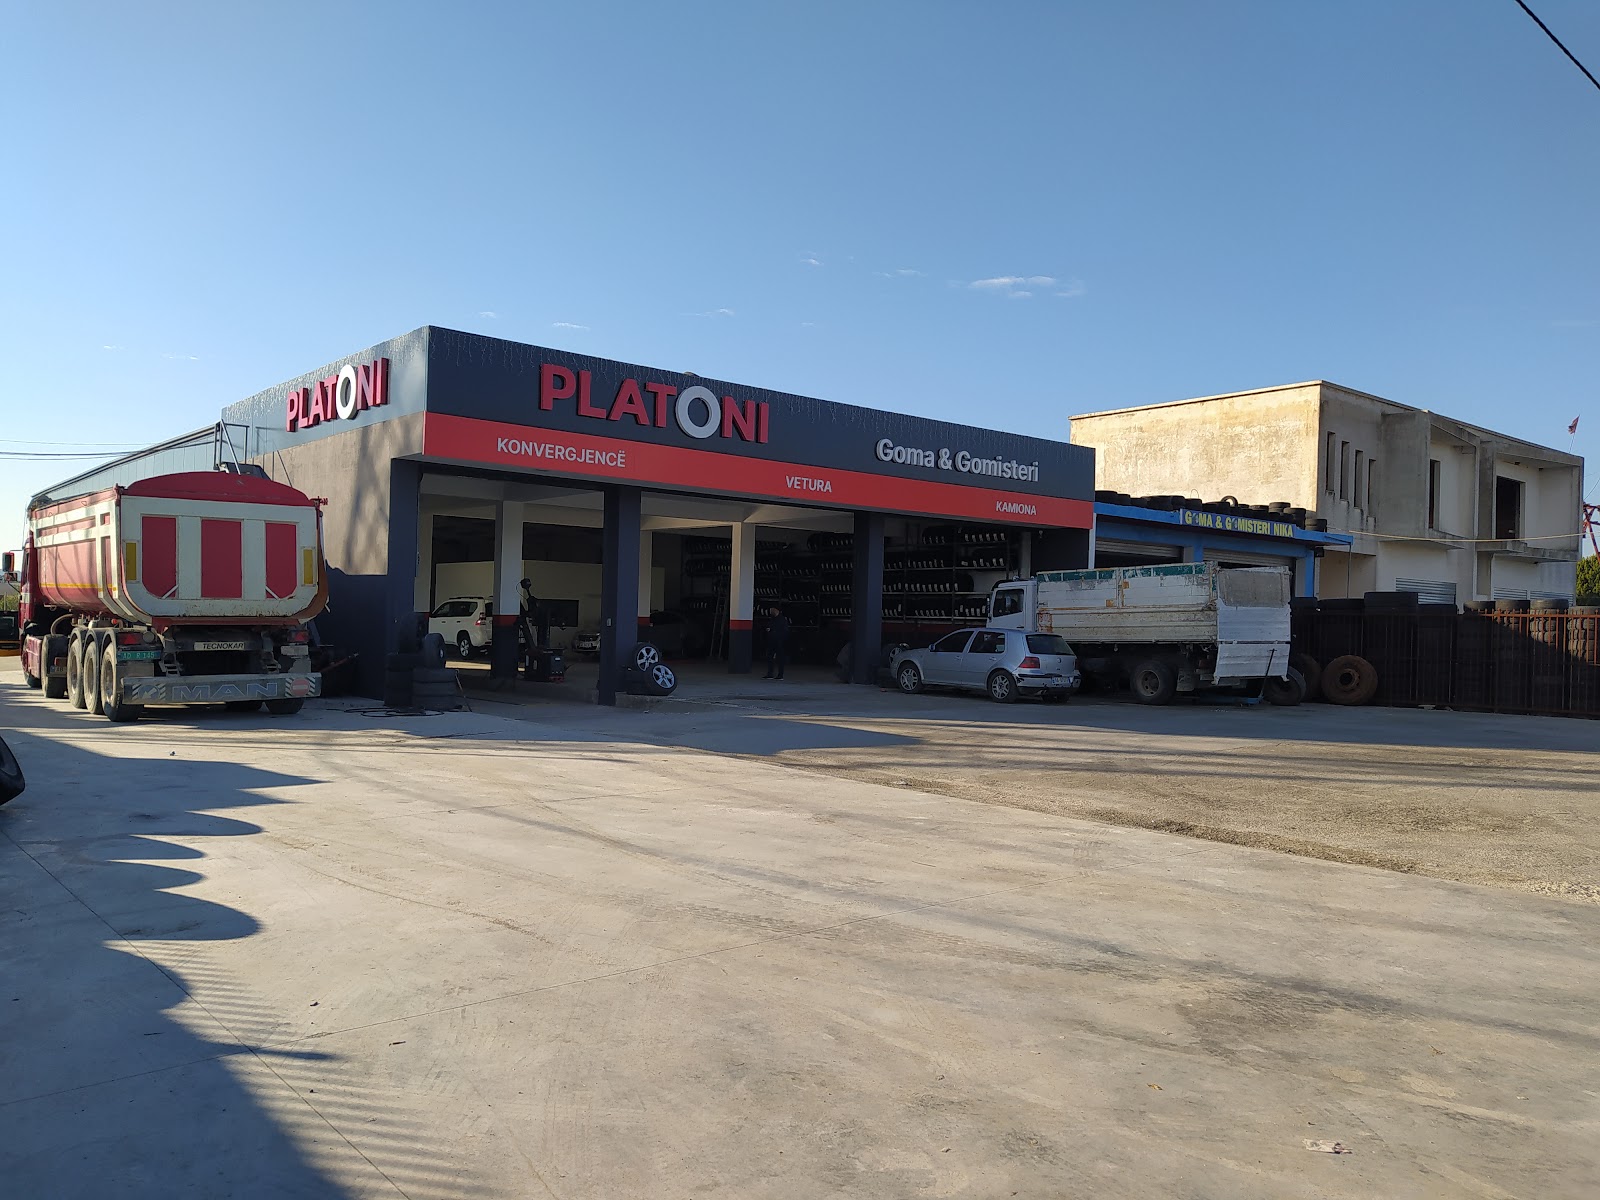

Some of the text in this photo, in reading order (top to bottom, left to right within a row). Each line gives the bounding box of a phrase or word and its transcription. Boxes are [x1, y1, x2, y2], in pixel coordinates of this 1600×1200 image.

[286, 357, 389, 432] PLATONI
[539, 363, 770, 443] PLATONI
[496, 437, 626, 468] KONVERGJENCË
[875, 438, 1039, 482] Goma & Gomisteri
[785, 475, 832, 493] VETURA
[995, 500, 1037, 515] KAMIONA
[1215, 516, 1223, 529] &
[1273, 523, 1293, 538] NIKA
[202, 642, 244, 650] TECNOKAR
[172, 683, 278, 701] MAN
